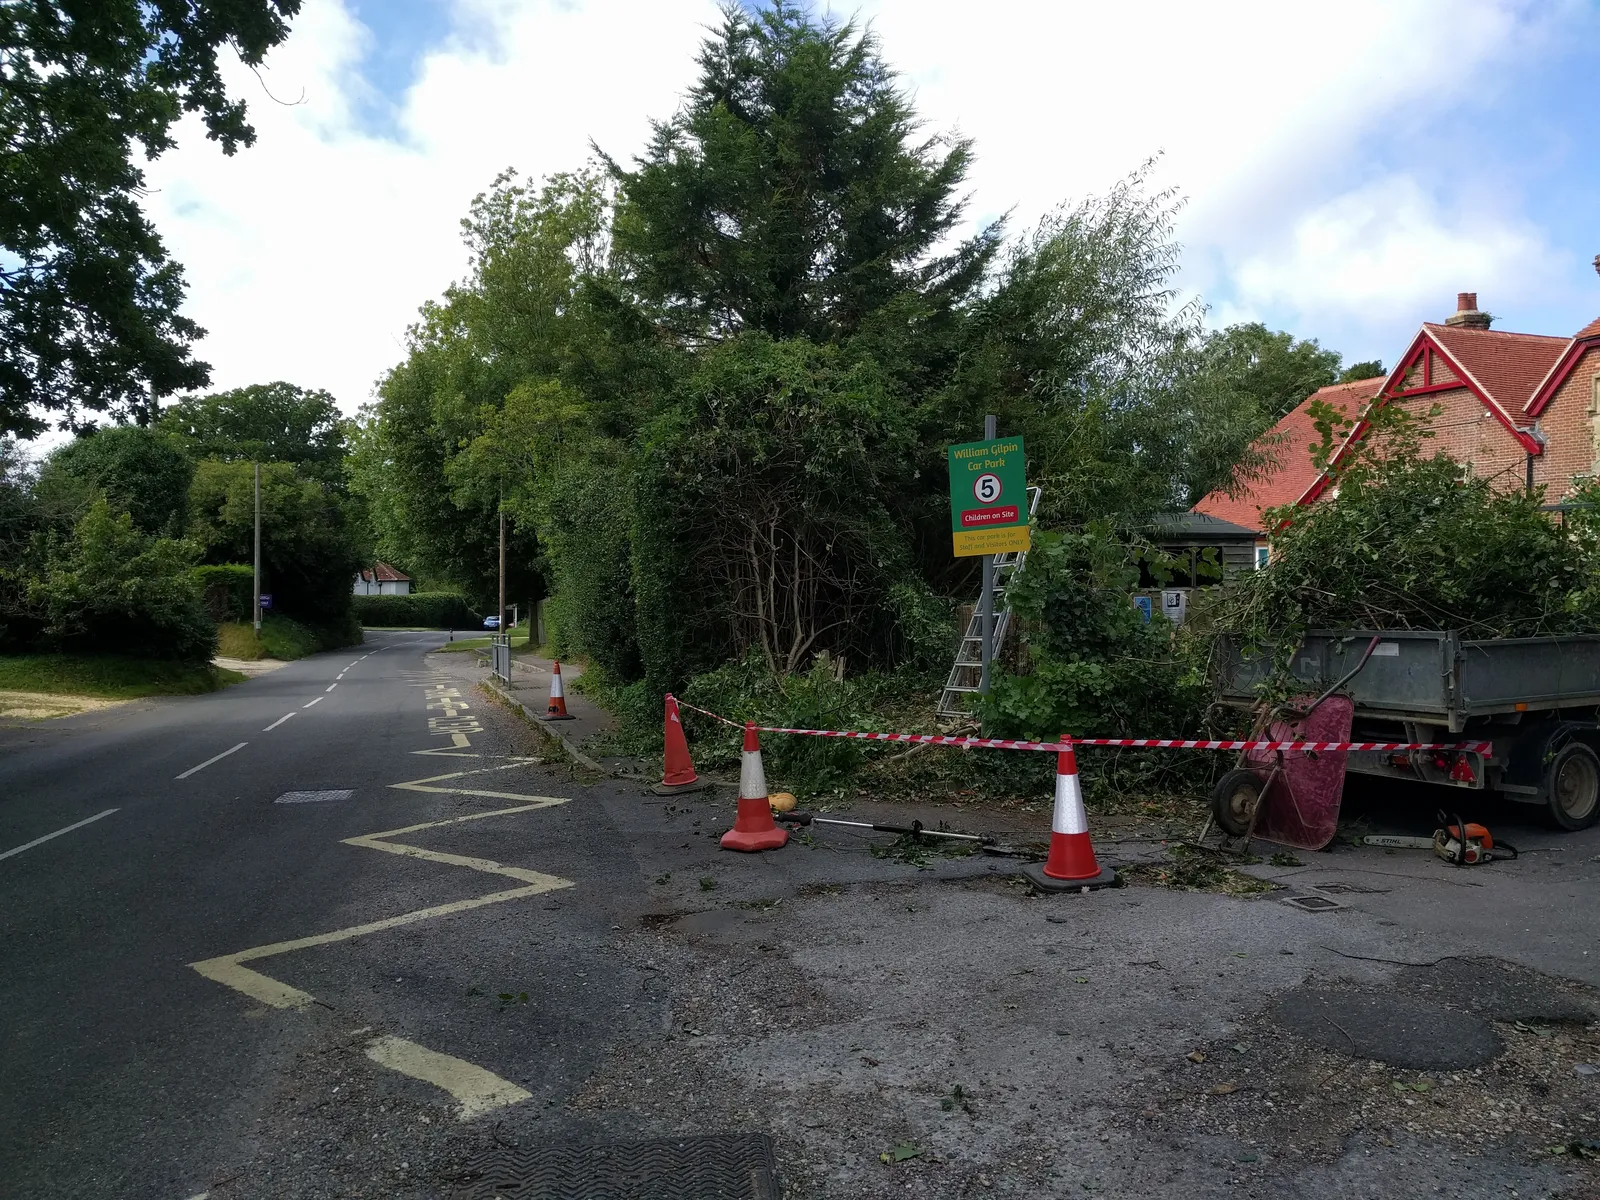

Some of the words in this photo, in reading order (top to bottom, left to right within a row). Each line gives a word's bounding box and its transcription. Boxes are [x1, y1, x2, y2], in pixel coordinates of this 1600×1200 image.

[954, 448, 988, 459] William
[991, 442, 1018, 456] Gilpin
[968, 462, 982, 470] Car
[985, 458, 1005, 468] Park
[981, 479, 994, 498] 5
[965, 513, 990, 522] Children
[987, 533, 999, 541] park
